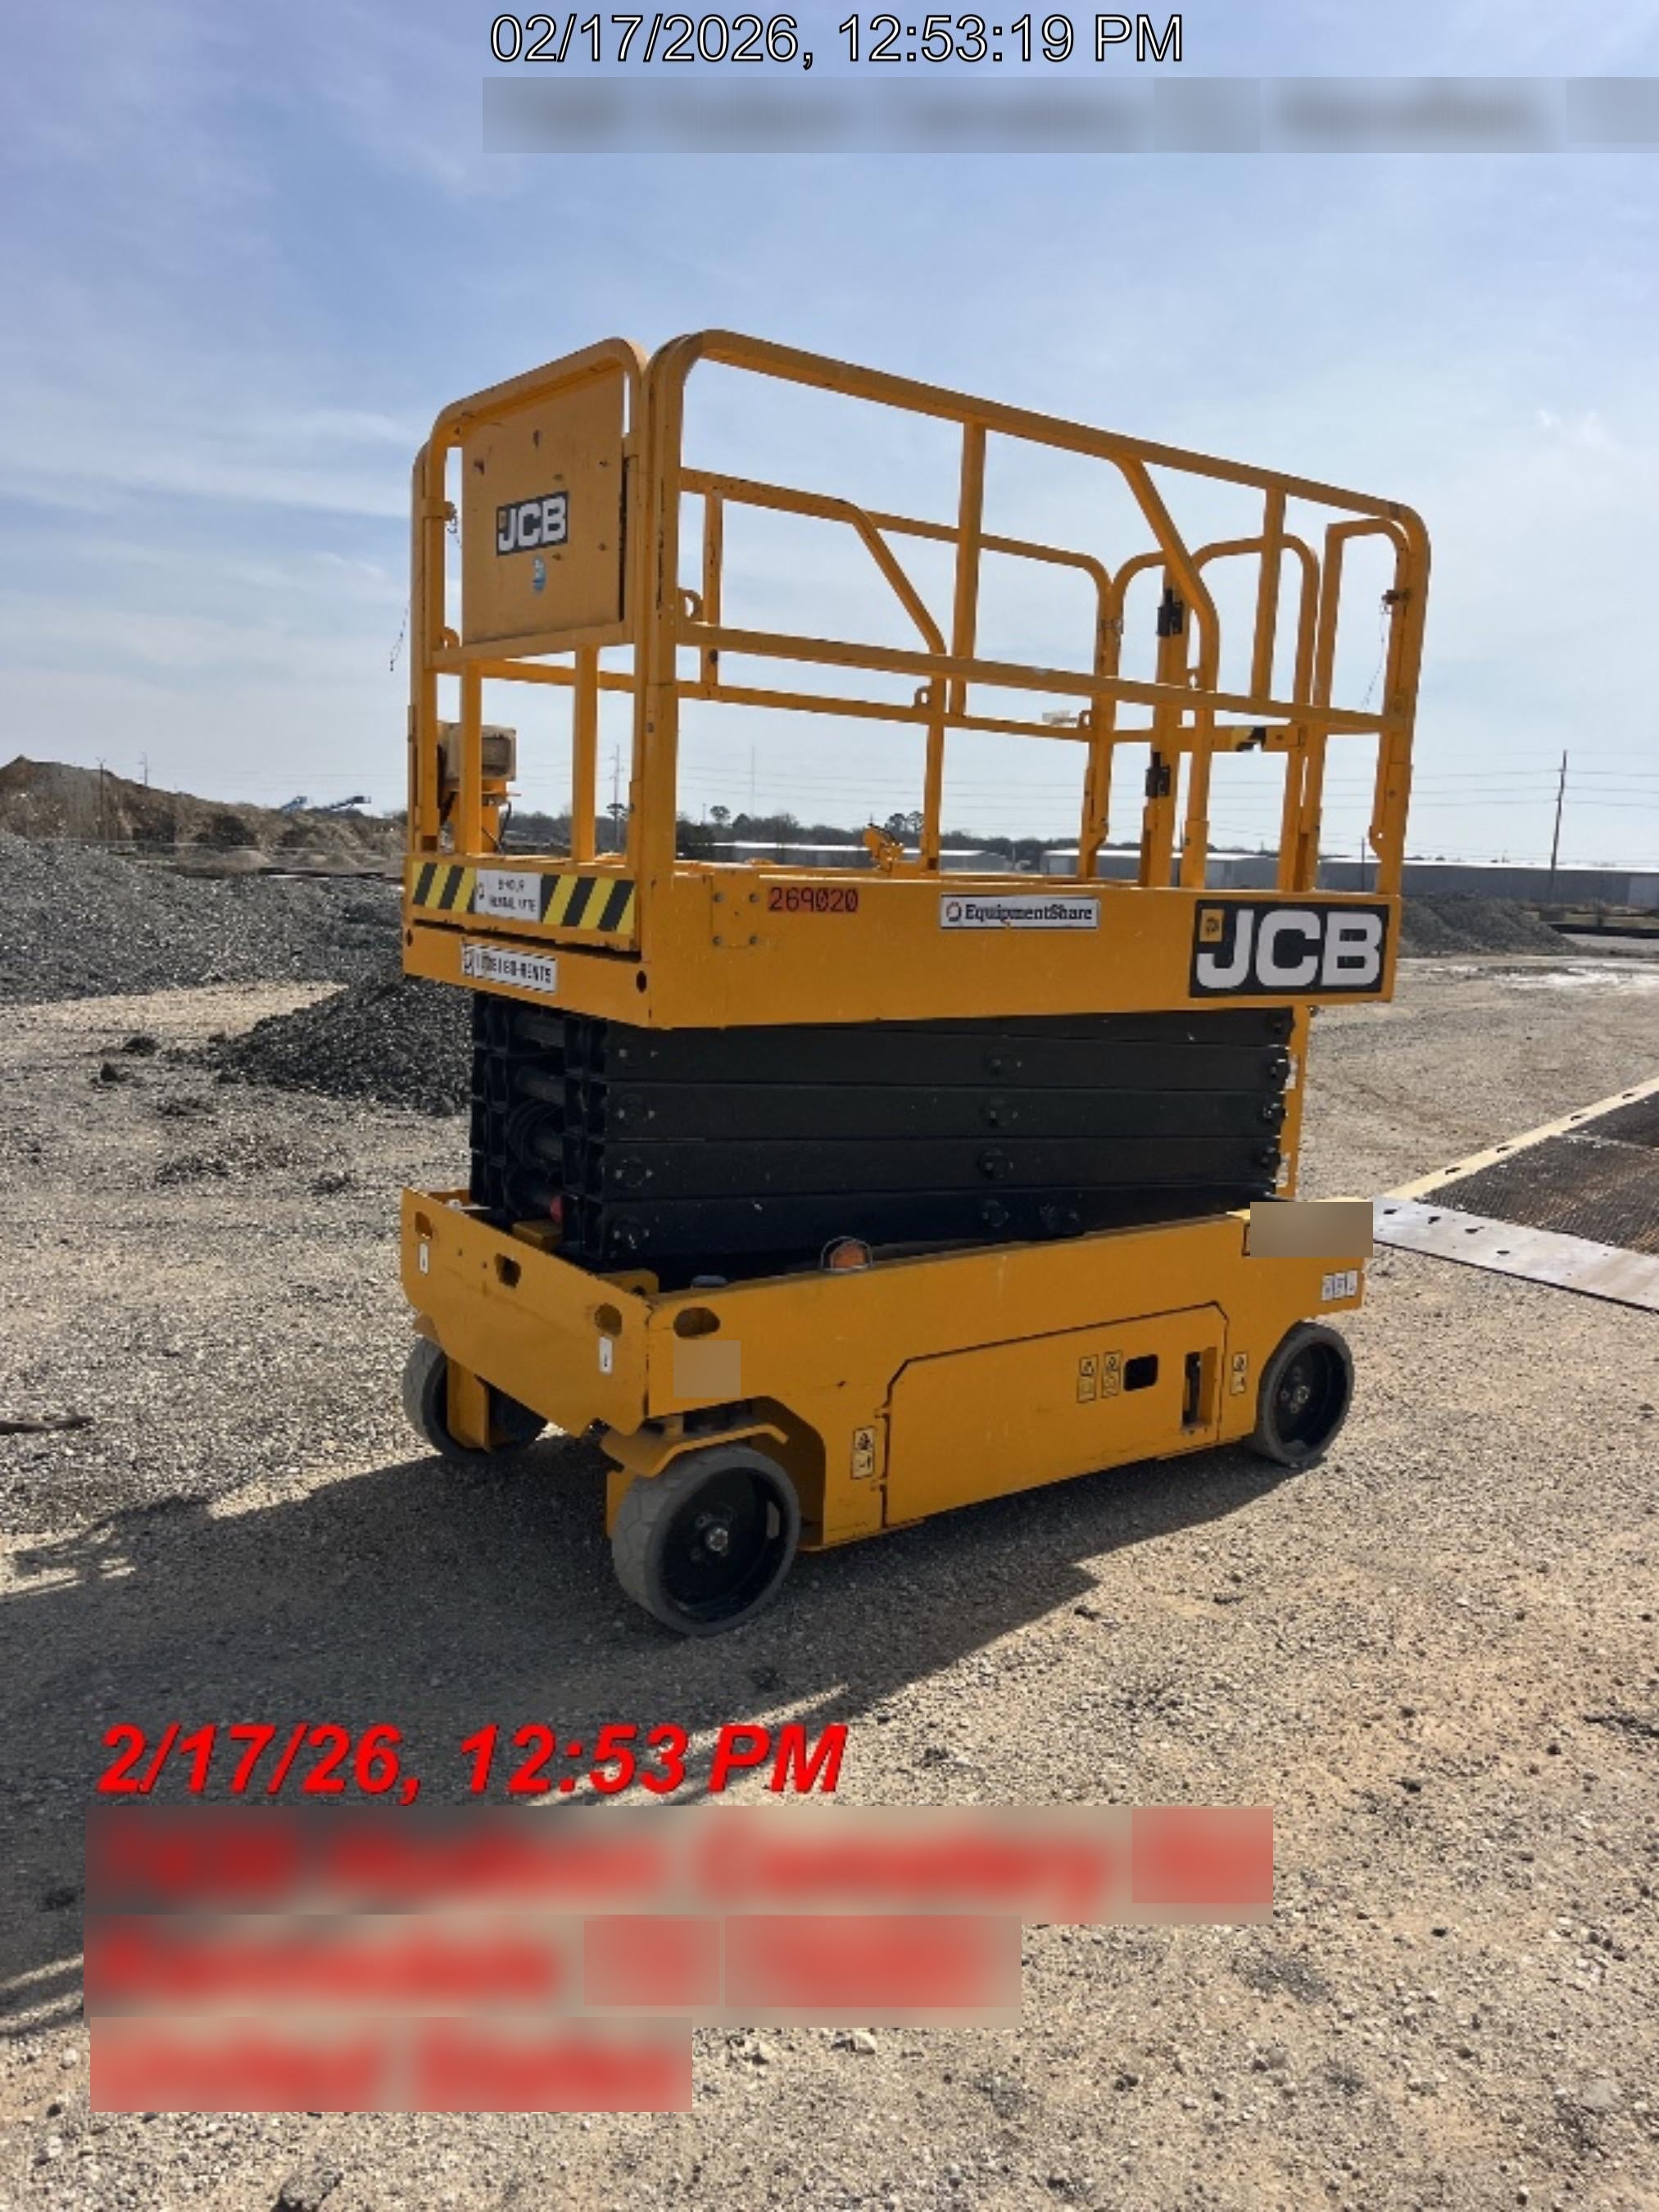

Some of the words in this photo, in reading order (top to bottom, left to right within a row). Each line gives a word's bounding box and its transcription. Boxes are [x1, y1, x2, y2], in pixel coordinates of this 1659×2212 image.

[497, 496, 567, 551] JCB
[768, 886, 859, 913] 269020
[964, 903, 1093, 922] EquipmentShare
[1196, 909, 1383, 990] JCB
